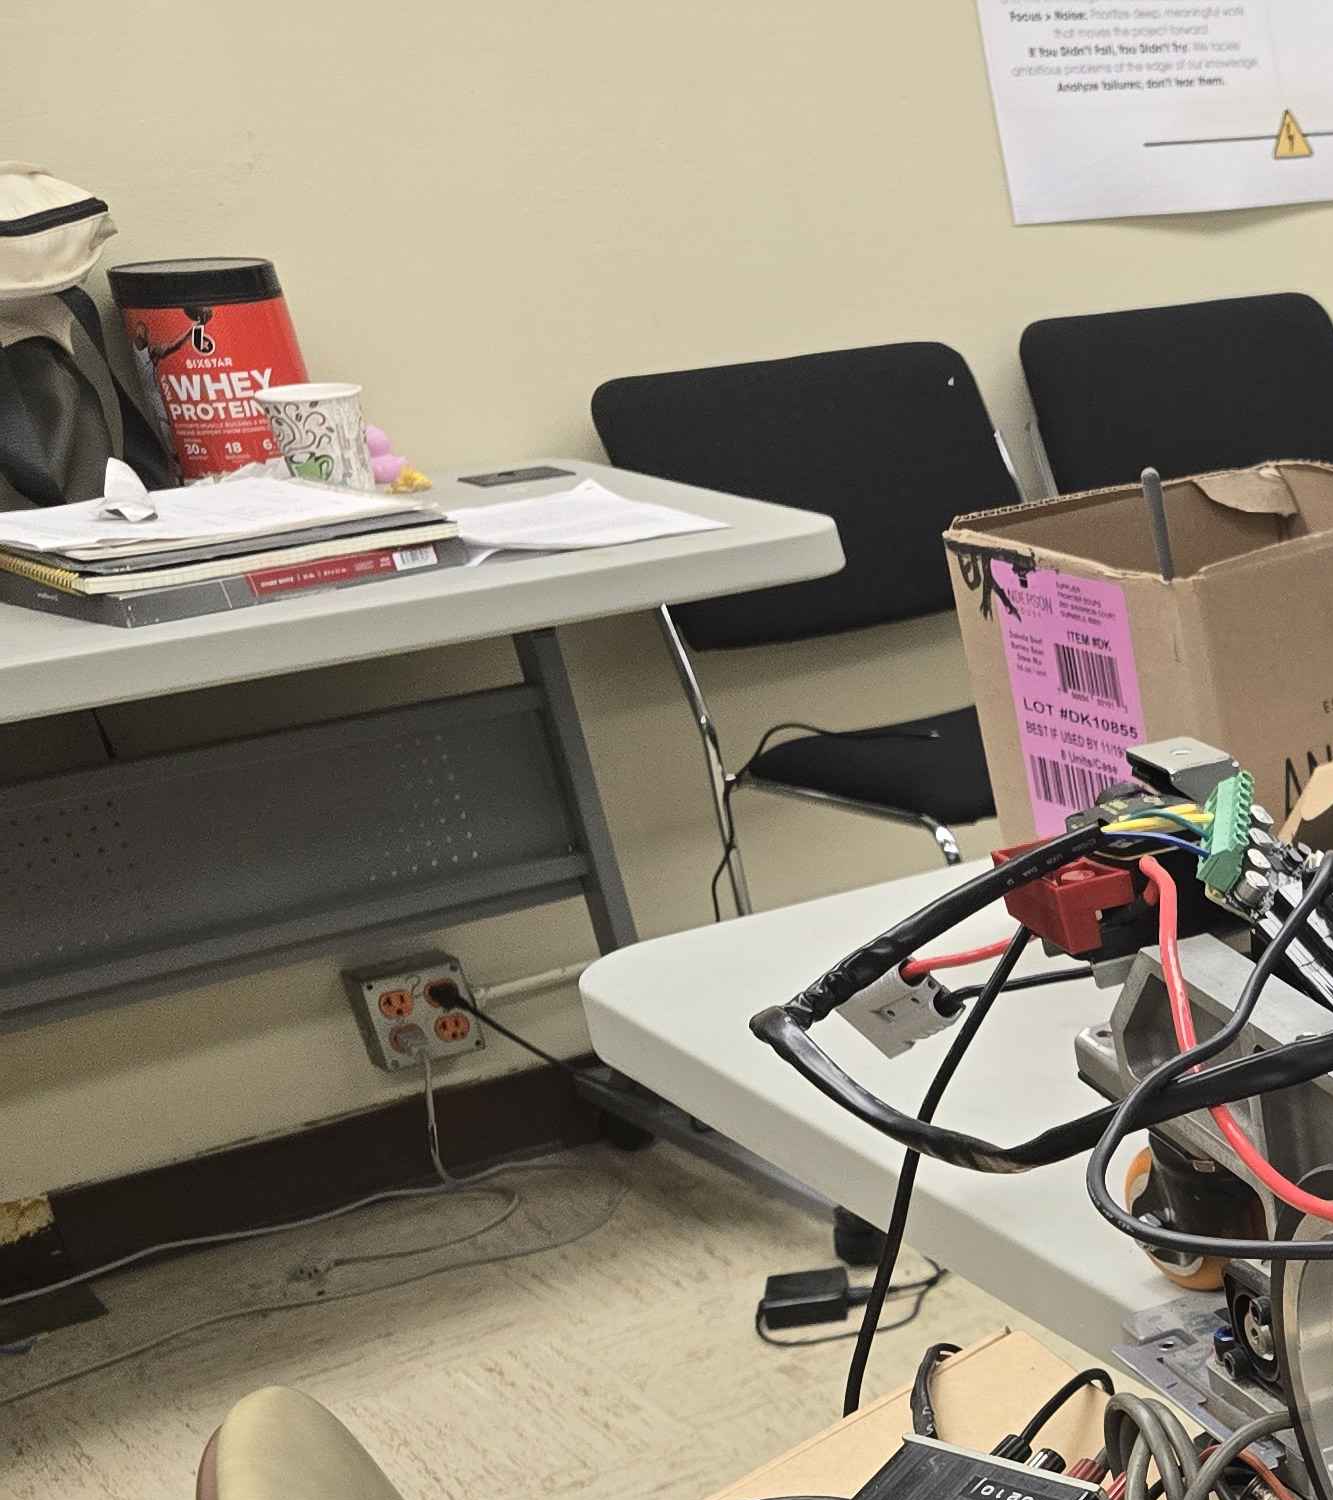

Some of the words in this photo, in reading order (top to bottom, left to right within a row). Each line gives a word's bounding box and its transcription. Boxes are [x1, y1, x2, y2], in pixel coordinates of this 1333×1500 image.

[1010, 11, 1041, 22] Focus
[1165, 7, 1219, 20] meaningful
[1053, 28, 1074, 38] that
[1077, 28, 1110, 38] moves
[1113, 26, 1131, 37] the
[1132, 26, 1167, 39] project
[1011, 64, 1062, 78] ambitious
[1064, 63, 1105, 77] problems
[1124, 60, 1144, 72] the
[1146, 60, 1173, 74] edge
[185, 356, 233, 370] SIXSTAR
[167, 368, 273, 401] WHEY
[169, 400, 268, 421] PROTEIN
[225, 442, 243, 454] 18
[1067, 630, 1090, 646] ITEM
[1023, 698, 1055, 716] LOT
[1026, 720, 1049, 737] BEST
[1060, 731, 1086, 748] USED
[1087, 737, 1099, 751] BY
[1068, 750, 1119, 775] Units/Case
